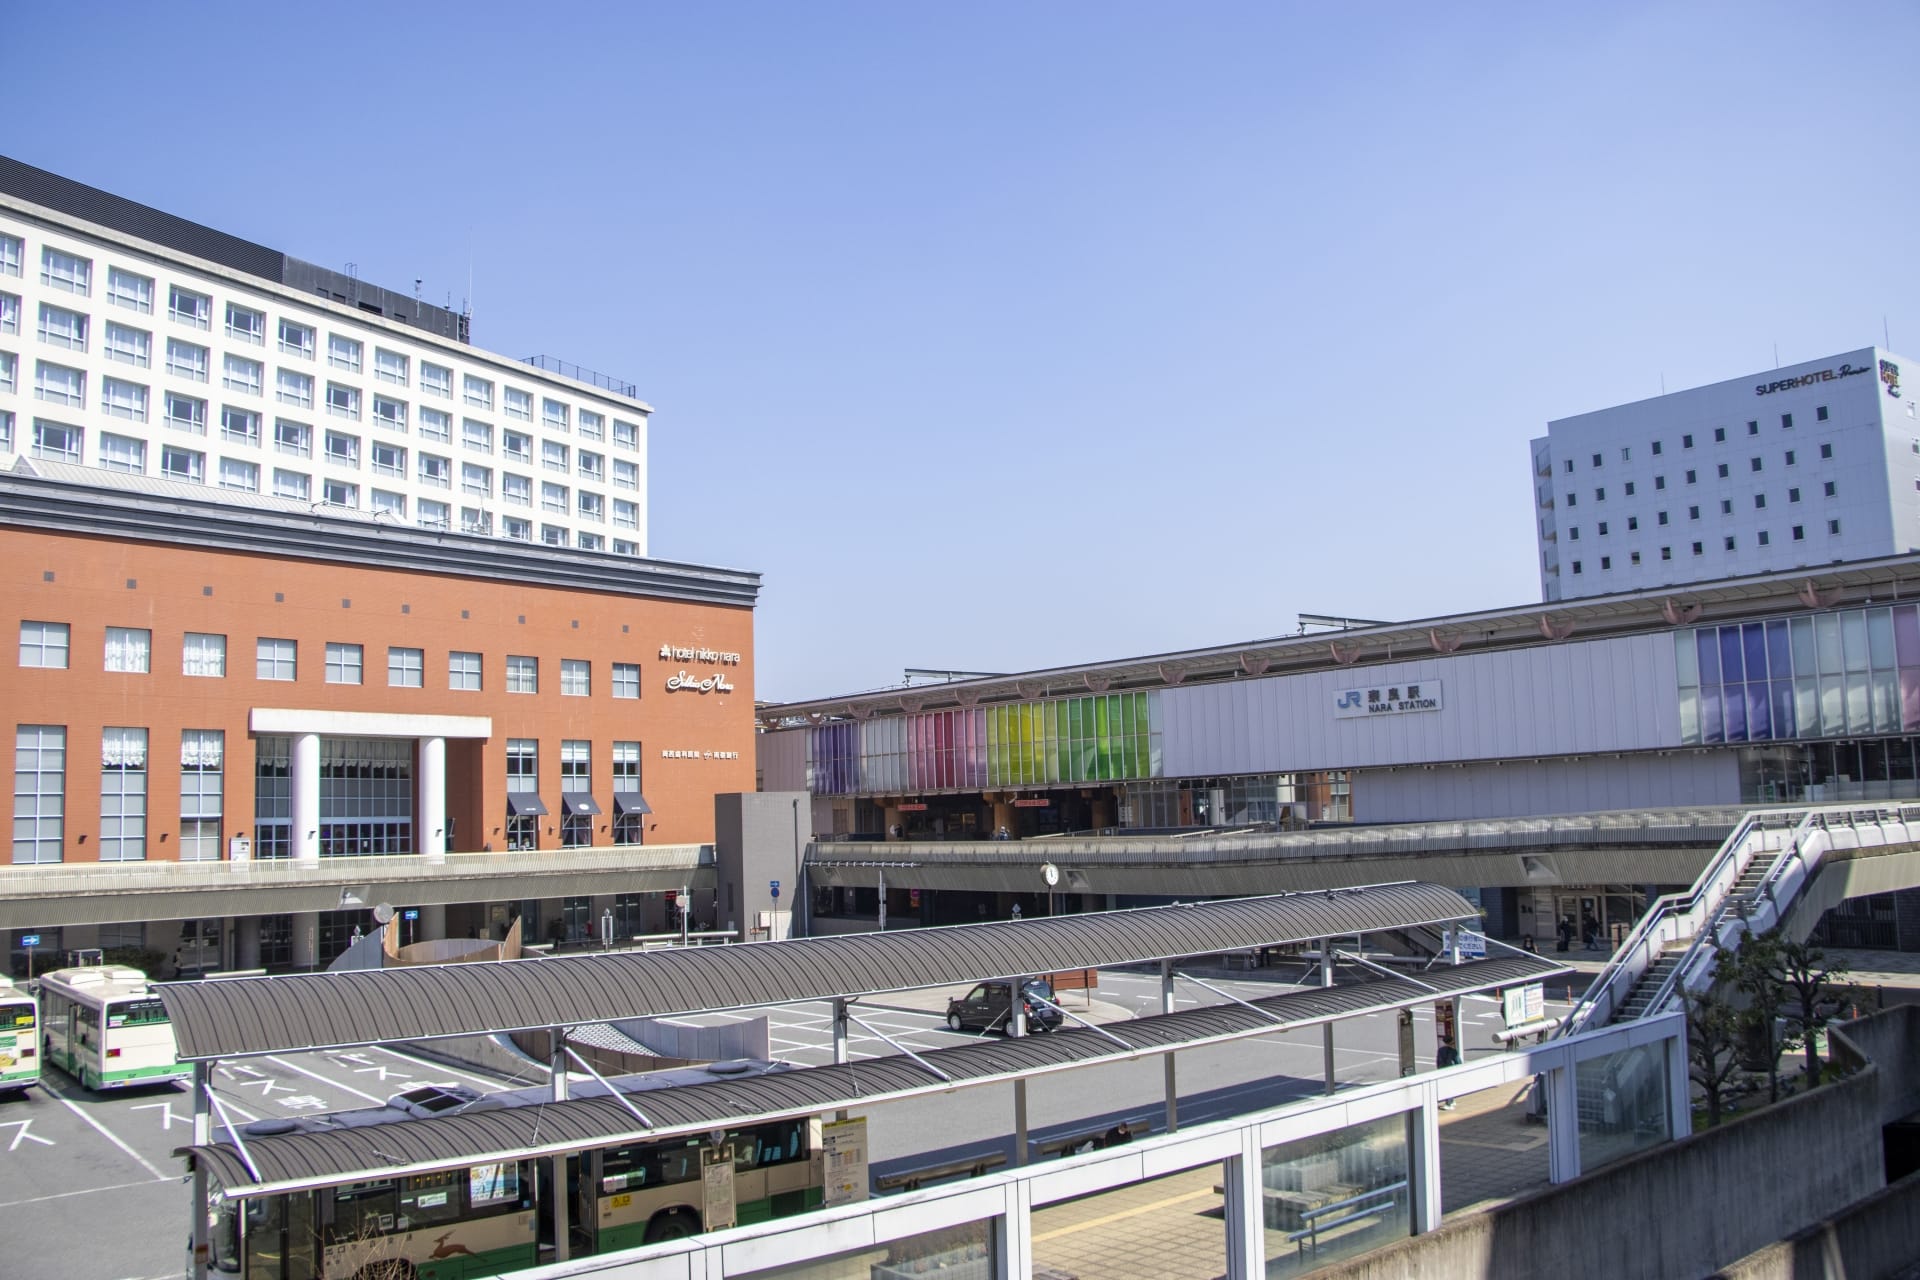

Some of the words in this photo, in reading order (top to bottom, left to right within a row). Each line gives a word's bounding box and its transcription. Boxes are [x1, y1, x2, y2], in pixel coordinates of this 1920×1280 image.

[673, 645, 695, 659] hotel
[695, 648, 719, 661] nikko
[719, 651, 741, 663] nara
[1338, 691, 1362, 709] JR
[1367, 685, 1421, 703] 奈良駅
[1368, 703, 1393, 713] NARA
[1398, 698, 1437, 711] STATION
